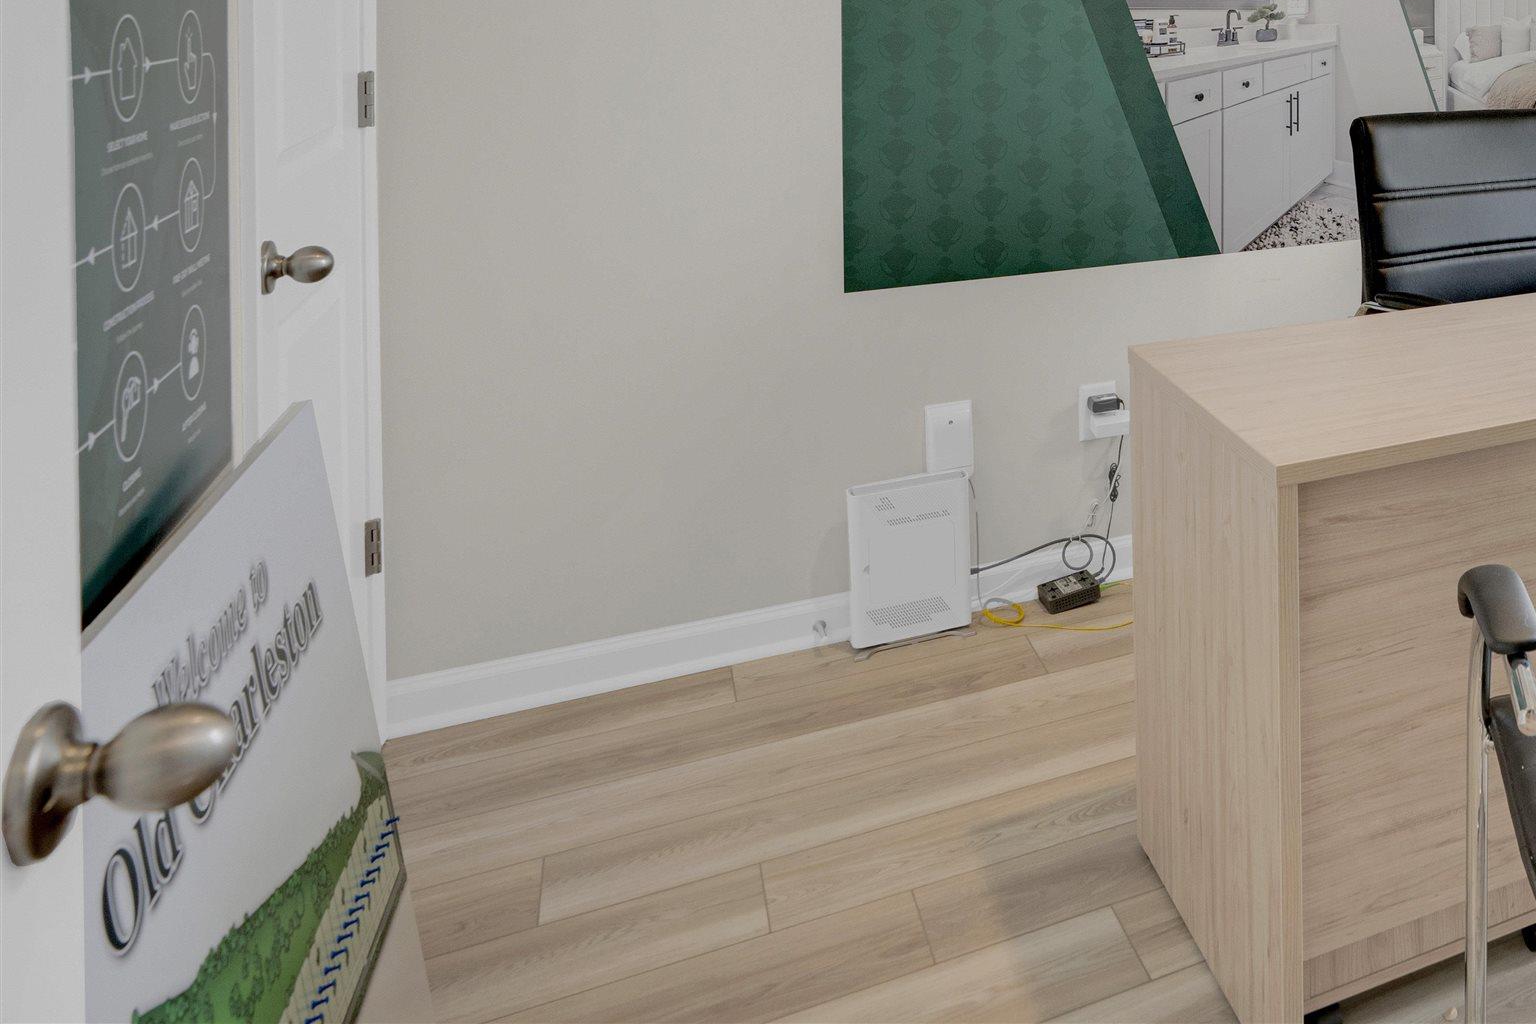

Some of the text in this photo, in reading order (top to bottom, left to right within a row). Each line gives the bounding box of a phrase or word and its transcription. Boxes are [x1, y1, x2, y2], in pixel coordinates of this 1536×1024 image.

[250, 560, 269, 614] to
[102, 577, 323, 956] Old arleston
